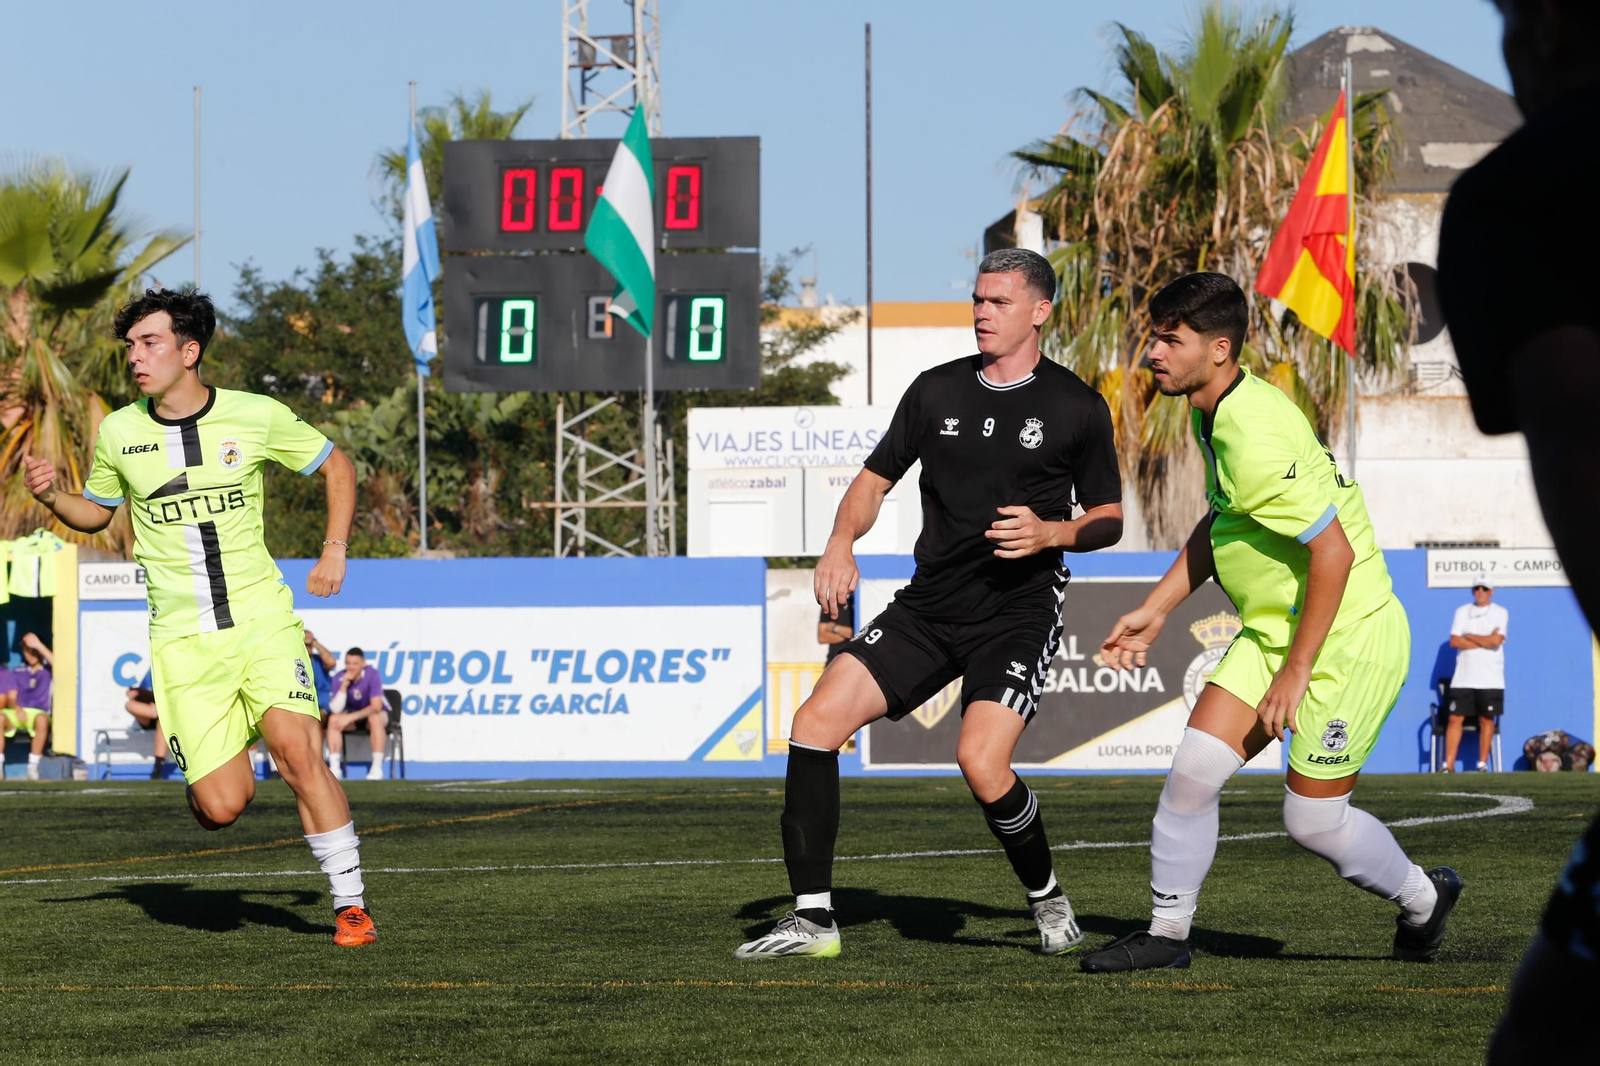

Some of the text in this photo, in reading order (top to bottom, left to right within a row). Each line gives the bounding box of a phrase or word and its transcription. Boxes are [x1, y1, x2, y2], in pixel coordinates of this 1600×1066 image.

[982, 417, 996, 437] 9
[122, 443, 159, 455] LEGEA
[696, 429, 888, 452] VIAJES LINEAS
[828, 476, 856, 488] VIS
[147, 489, 246, 525] LOTUS
[1435, 561, 1486, 572] FUTBOL
[1489, 561, 1497, 572] 7
[1514, 560, 1562, 572] CAMPO
[85, 574, 131, 585] CAMPO
[864, 628, 883, 645] 9
[531, 648, 731, 684] "FLORES"
[401, 688, 630, 715] ONZÁLEZ GARCÍA
[169, 735, 188, 772] 8
[1098, 745, 1143, 757] LUCHA
[1145, 745, 1174, 757] POR
[1307, 753, 1350, 765] LEGEA
